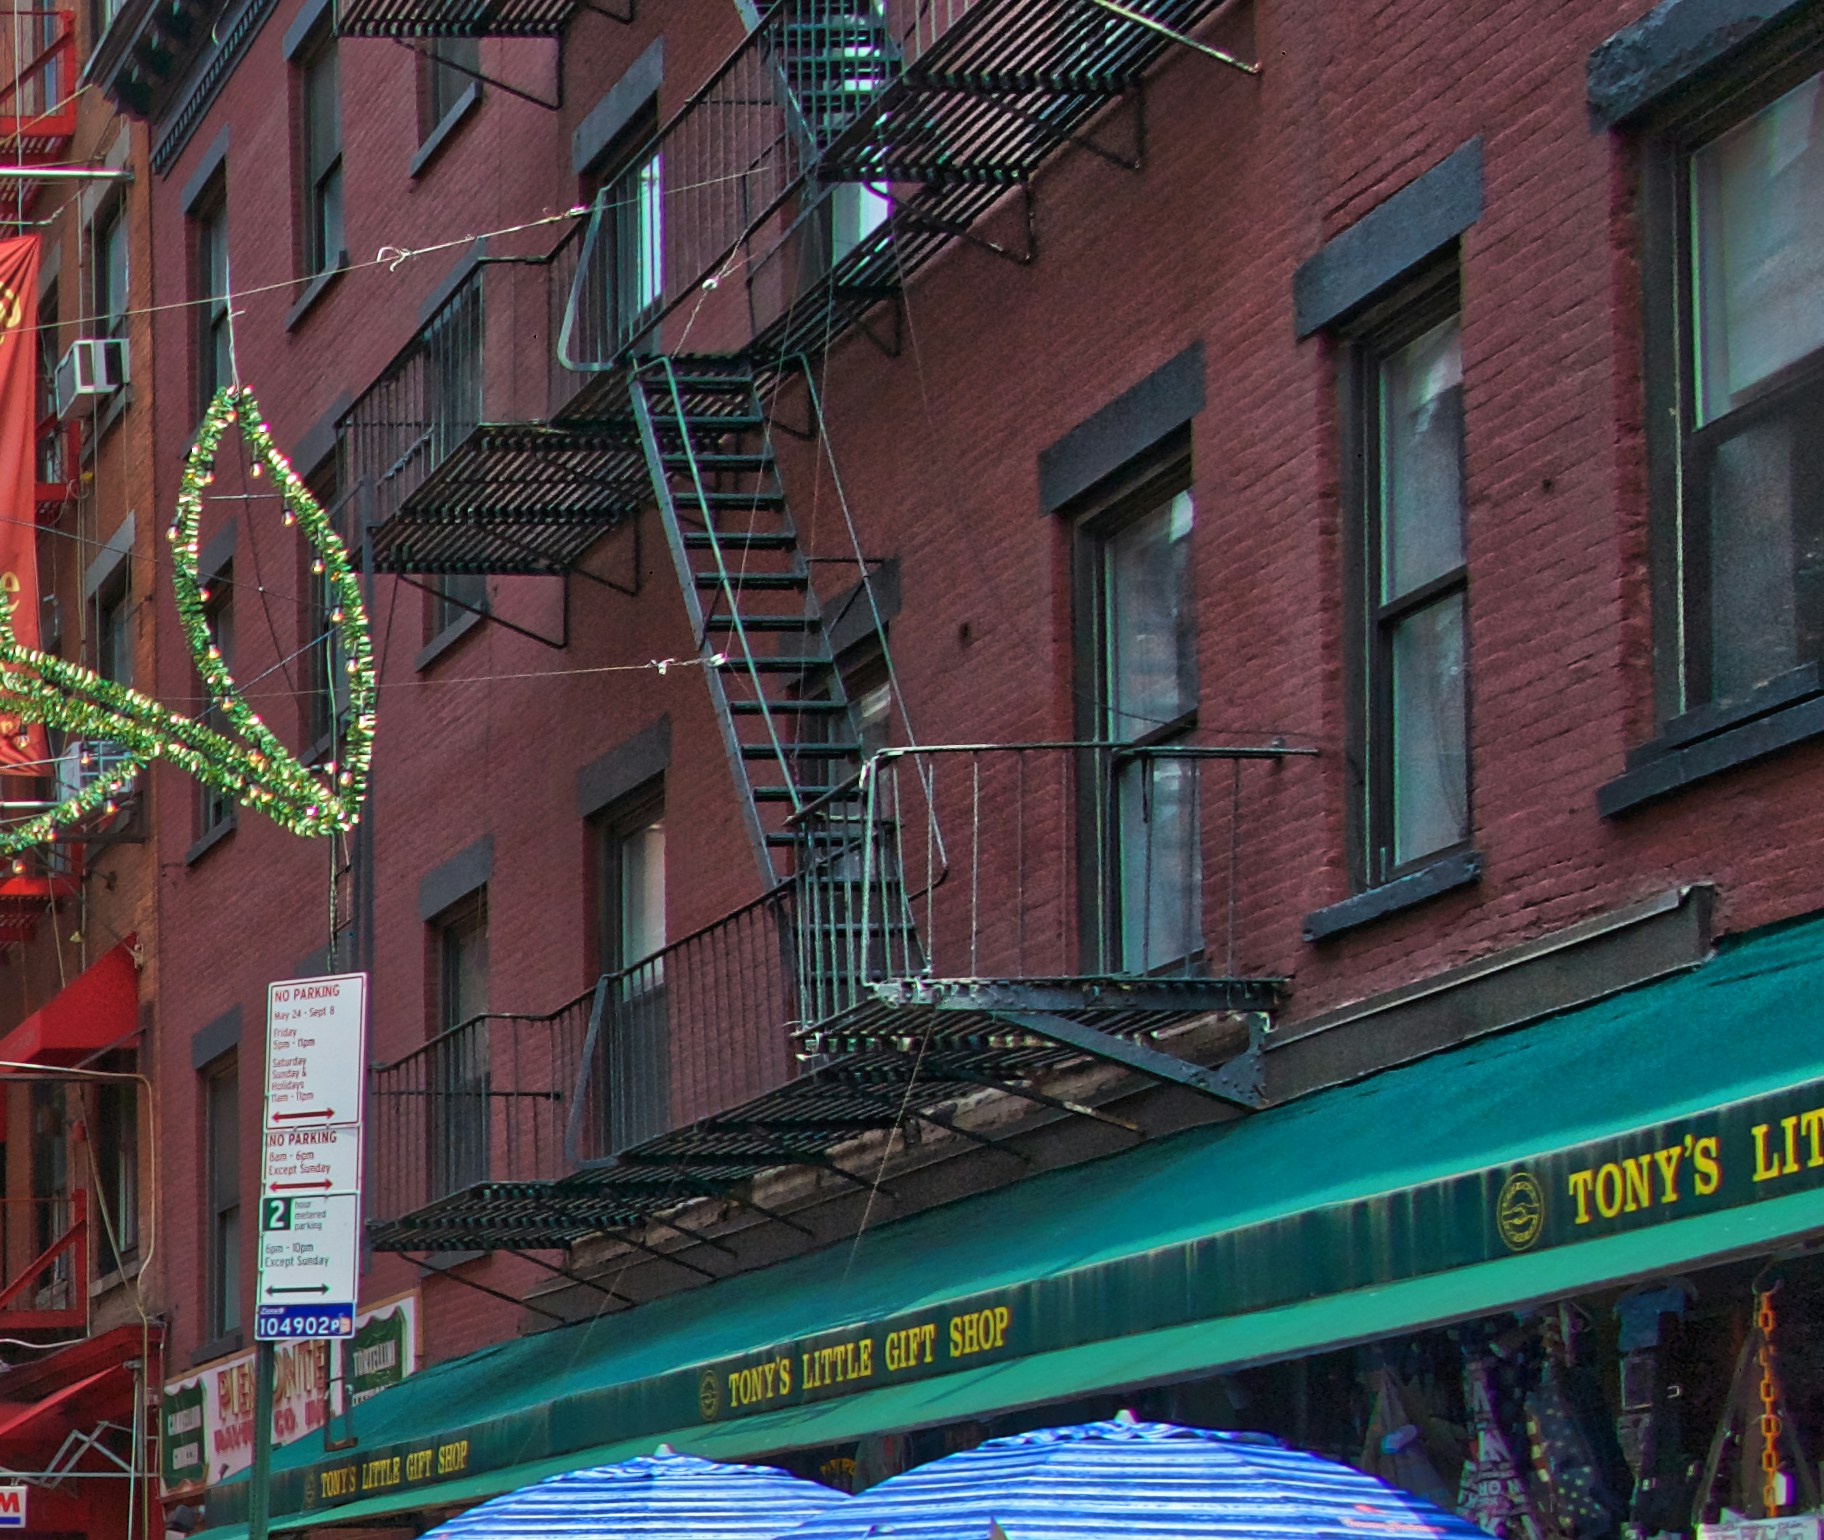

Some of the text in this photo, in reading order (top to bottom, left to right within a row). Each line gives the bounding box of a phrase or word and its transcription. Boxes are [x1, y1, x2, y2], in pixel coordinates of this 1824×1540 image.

[275, 984, 340, 1002] NO PARKING
[292, 1008, 301, 1018] 24
[309, 1007, 326, 1018] Sept
[272, 1057, 307, 1069] Saturday
[272, 1070, 299, 1080] Sunday
[269, 1131, 337, 1146] NO PARKING
[269, 1163, 331, 1176] Except Sunday
[1568, 1133, 1721, 1226] TONY'S
[270, 1200, 284, 1228] 2
[294, 1221, 323, 1231] parking
[265, 1255, 329, 1268] Except Sunday
[728, 1355, 792, 1408] TONY'S
[802, 1338, 872, 1390] LITTLE
[884, 1323, 935, 1371] GIFT
[949, 1306, 1009, 1357] SHOP
[321, 1440, 468, 1498] TONY'S LITTLE GIFT SHOP
